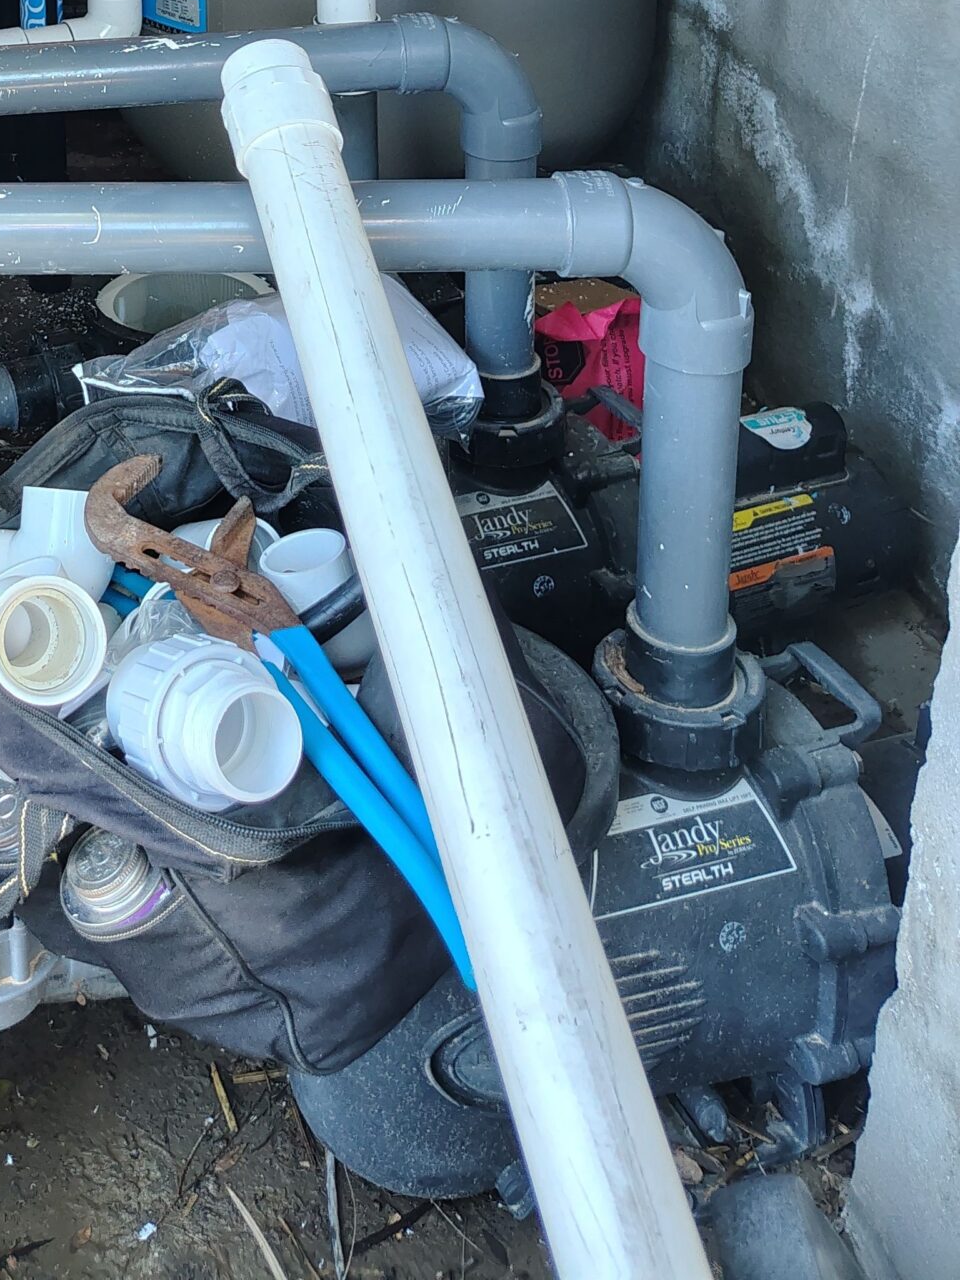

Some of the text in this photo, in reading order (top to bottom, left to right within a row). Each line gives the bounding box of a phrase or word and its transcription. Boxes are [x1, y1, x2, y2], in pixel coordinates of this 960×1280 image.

[471, 506, 530, 541] Jandy
[510, 524, 527, 535] Pro
[527, 520, 553, 531] Series
[483, 539, 540, 560] STEALTH
[644, 815, 720, 865] Jandy
[696, 834, 752, 858] Pro Series
[661, 861, 735, 891] STEALTH
